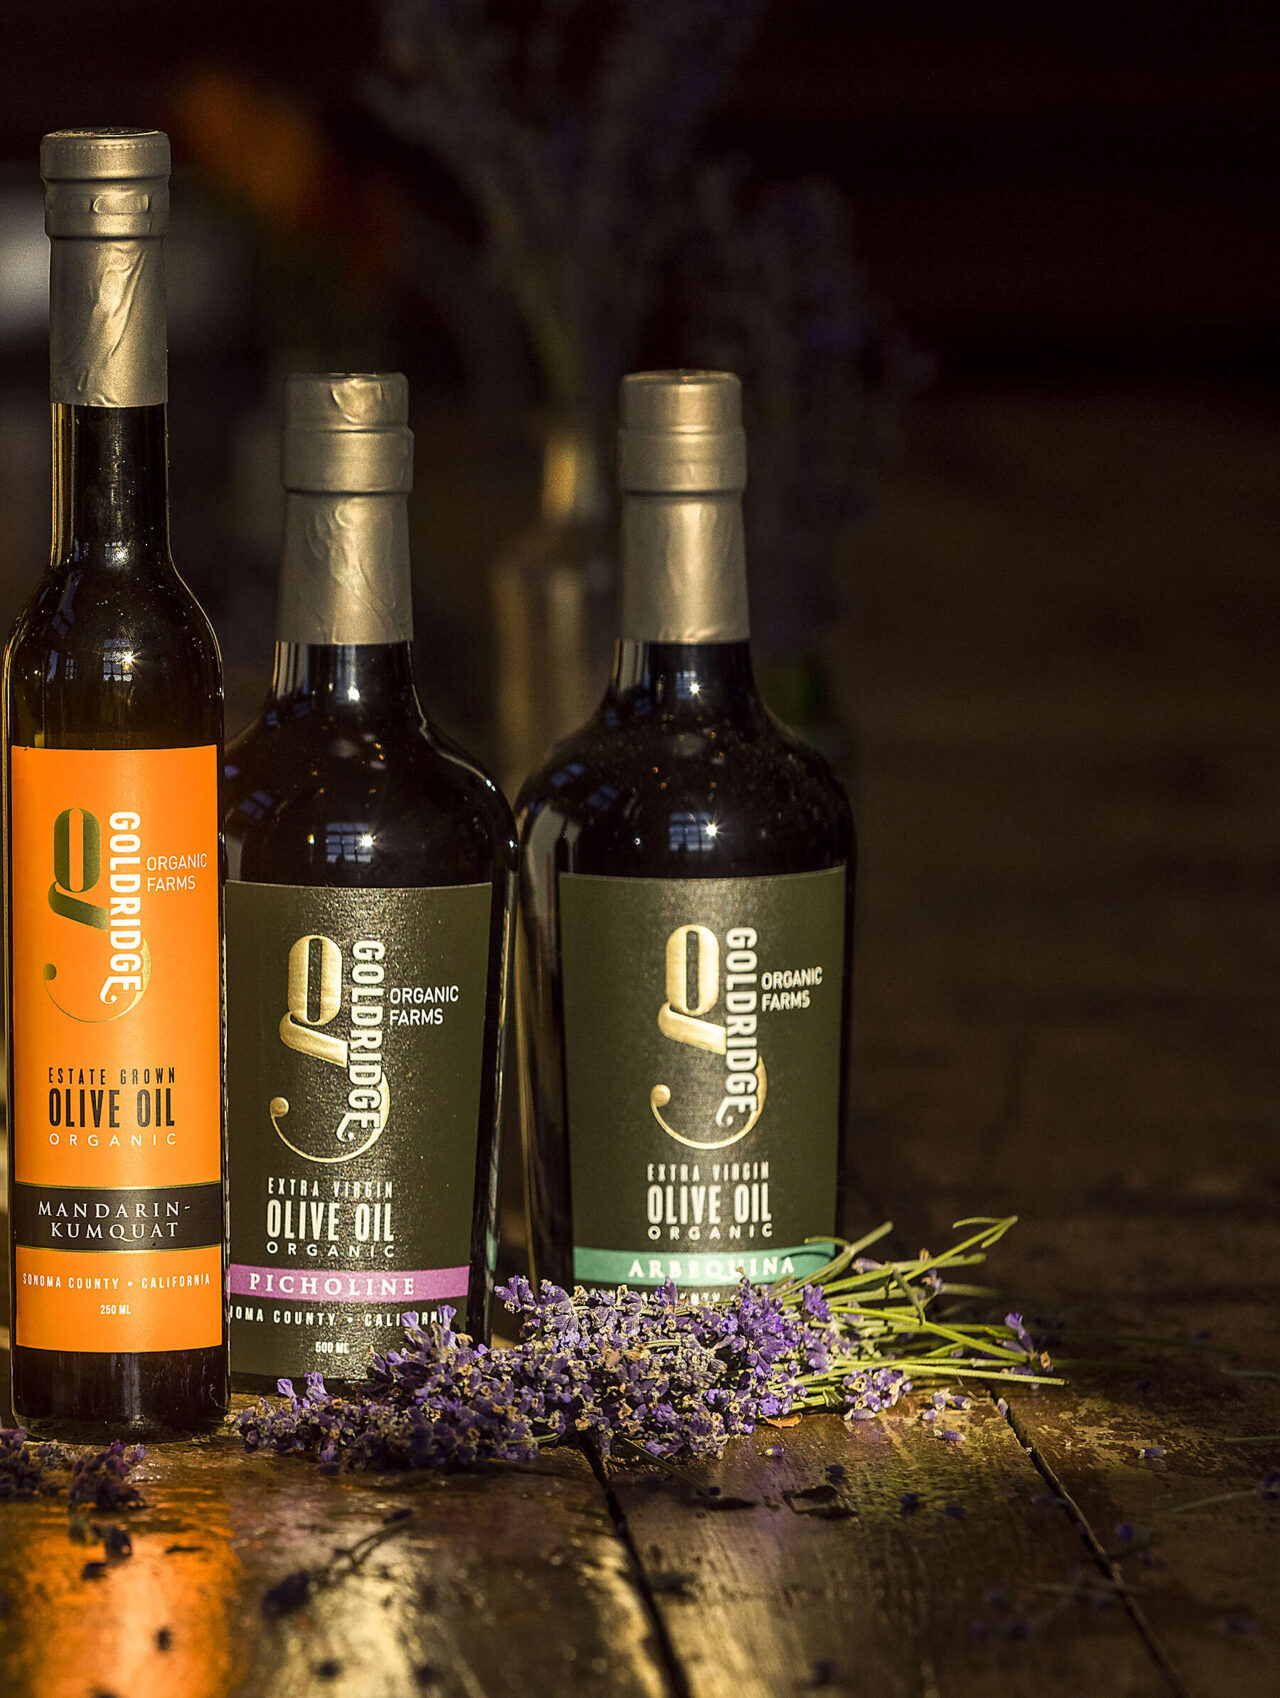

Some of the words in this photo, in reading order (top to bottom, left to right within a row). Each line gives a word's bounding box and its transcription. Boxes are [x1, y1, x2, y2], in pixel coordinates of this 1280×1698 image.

[146, 853, 207, 871] ORGANIC
[147, 874, 196, 892] FARMS
[99, 811, 142, 1005] GOLDRIDGE
[761, 967, 823, 991] ORGANIC
[389, 985, 459, 1005] ORGANIC
[761, 991, 811, 1012] FARMS
[390, 1006, 444, 1026] FARMS
[715, 927, 757, 1127] GOLDRIDGE
[336, 940, 386, 1142] GOLDRIDGE
[48, 1067, 107, 1086] ESTATE
[120, 1067, 177, 1086] GROWN
[48, 1089, 121, 1129] OLIVE
[137, 1088, 176, 1128] OIL
[49, 1132, 178, 1148] ORGANIC
[647, 1161, 701, 1182] EXTRA
[712, 1161, 770, 1182] VIRGIN
[268, 1177, 320, 1197] EXTRA
[333, 1180, 393, 1199] VIRGIN
[38, 1200, 191, 1219] MANDARIN-
[647, 1184, 723, 1225] OLIVE
[734, 1183, 772, 1223] OIL
[267, 1200, 340, 1242] OLIVE
[355, 1200, 395, 1242] OIL
[51, 1220, 179, 1244] KUMQUAT
[647, 1222, 773, 1241] ORGANIC
[267, 1241, 395, 1259] ORGANIC
[628, 1256, 795, 1282] ARBEQUINA
[22, 1273, 62, 1289] SONOMA
[67, 1275, 120, 1290] COUNTY
[141, 1273, 210, 1289] CALIFORNIA
[249, 1272, 415, 1296] PICHOLINE
[100, 1303, 117, 1316] 250
[118, 1303, 131, 1316] ML
[273, 1309, 336, 1326] COUNTY
[315, 1341, 333, 1353] 500
[336, 1341, 350, 1354] ML
